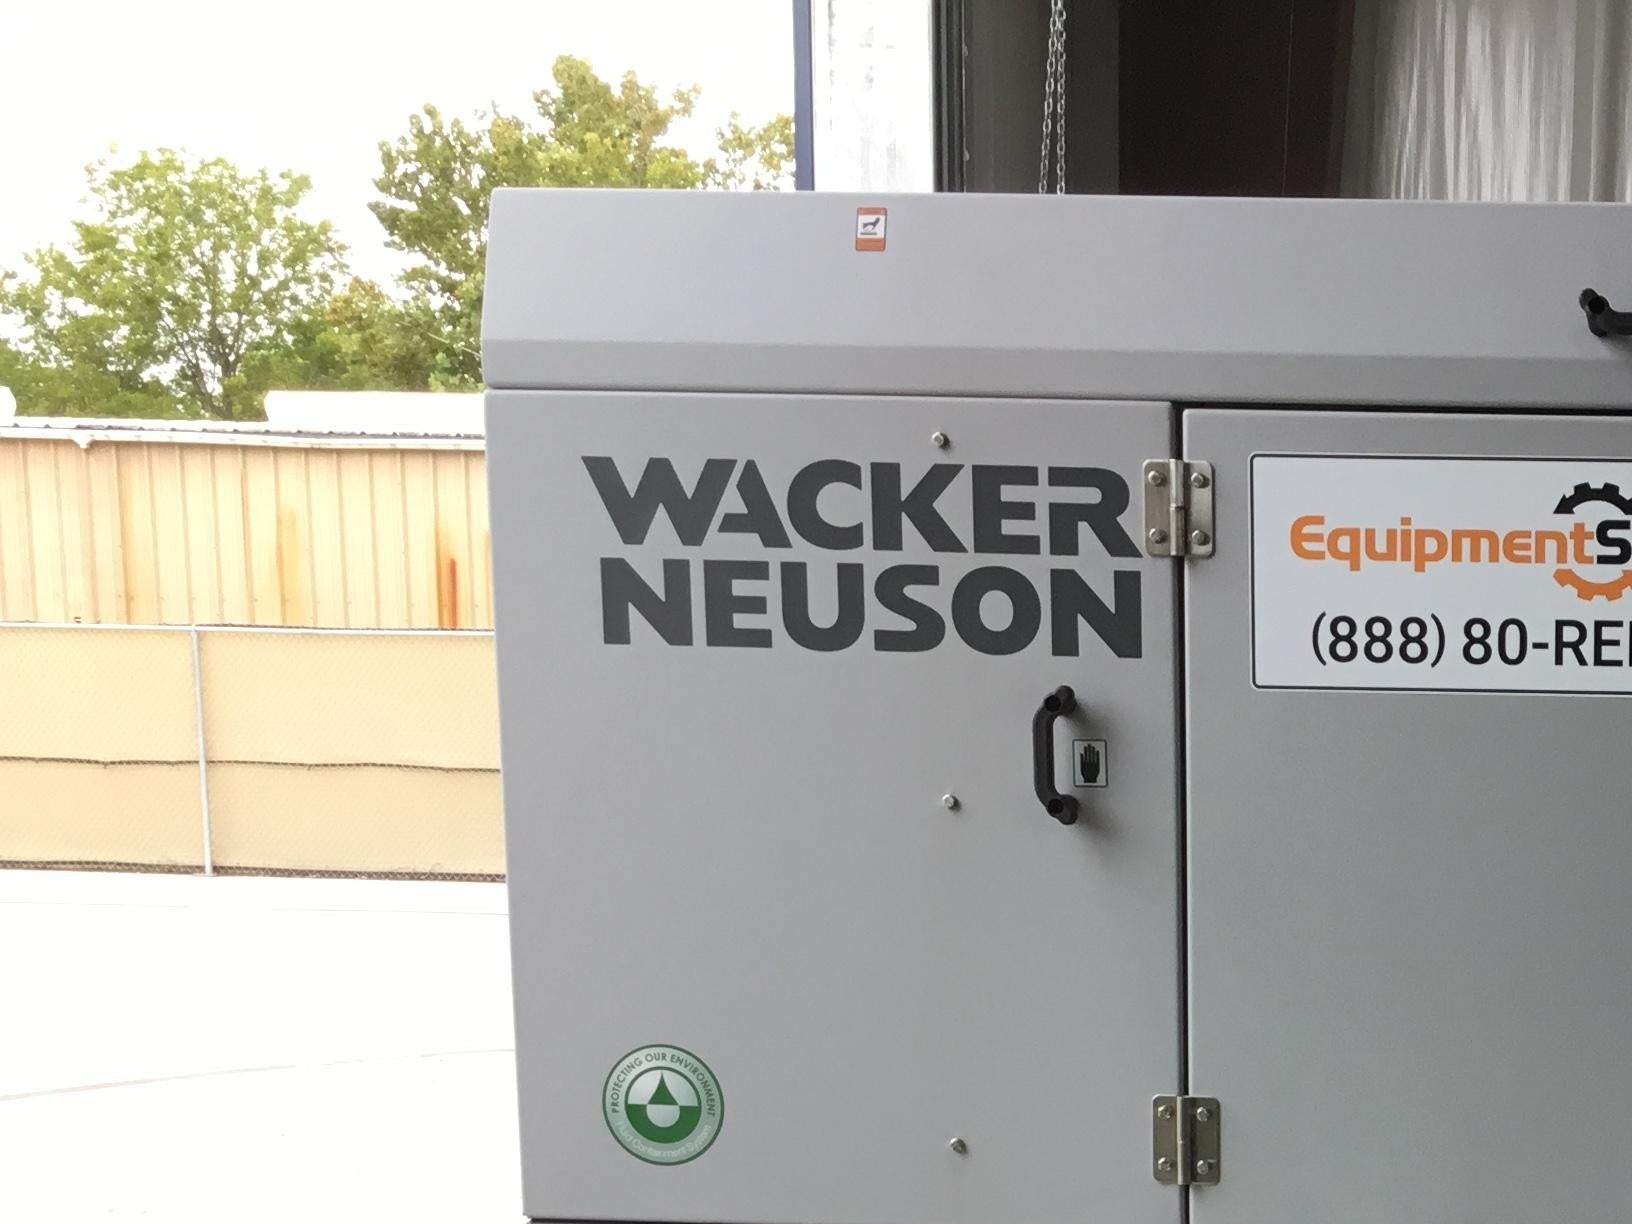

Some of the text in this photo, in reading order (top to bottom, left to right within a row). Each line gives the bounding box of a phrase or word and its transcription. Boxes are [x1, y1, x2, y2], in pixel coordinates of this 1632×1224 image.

[581, 456, 1143, 558] WACKER
[600, 557, 1142, 658] NEUSON
[1311, 612, 1445, 668] (888)
[611, 1052, 717, 1118] PROTECTING OUR ENVIRONMENT
